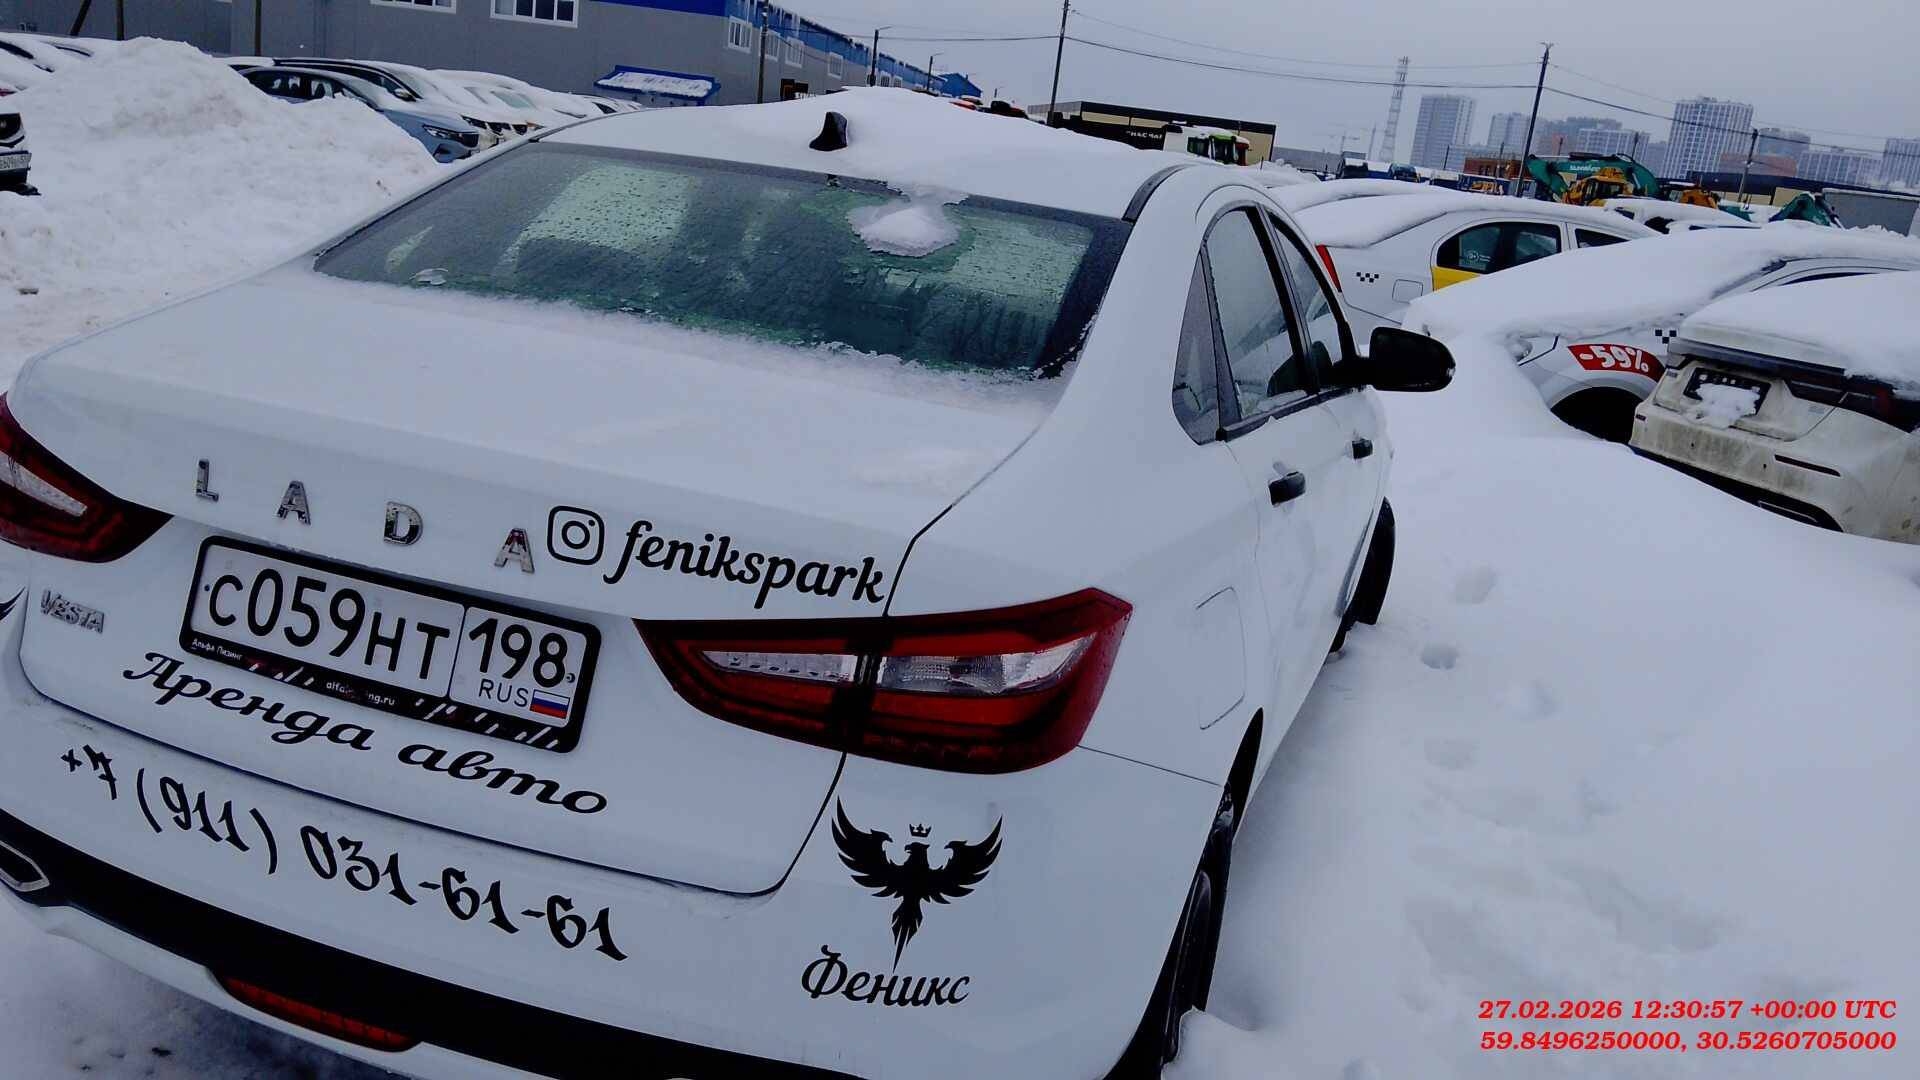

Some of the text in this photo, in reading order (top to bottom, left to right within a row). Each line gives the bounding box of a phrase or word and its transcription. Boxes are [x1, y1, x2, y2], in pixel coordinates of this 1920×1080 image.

[1580, 345, 1649, 373] -59%
[195, 459, 535, 574] LADA
[603, 520, 885, 610] fenikspark
[40, 589, 105, 634] VESTA
[209, 569, 568, 688] С059НТ 198
[122, 652, 608, 813] Аренда авто
[478, 678, 529, 707] RUS
[60, 744, 628, 961] +7 (911) 031-61-61
[801, 944, 970, 1007] Феникс
